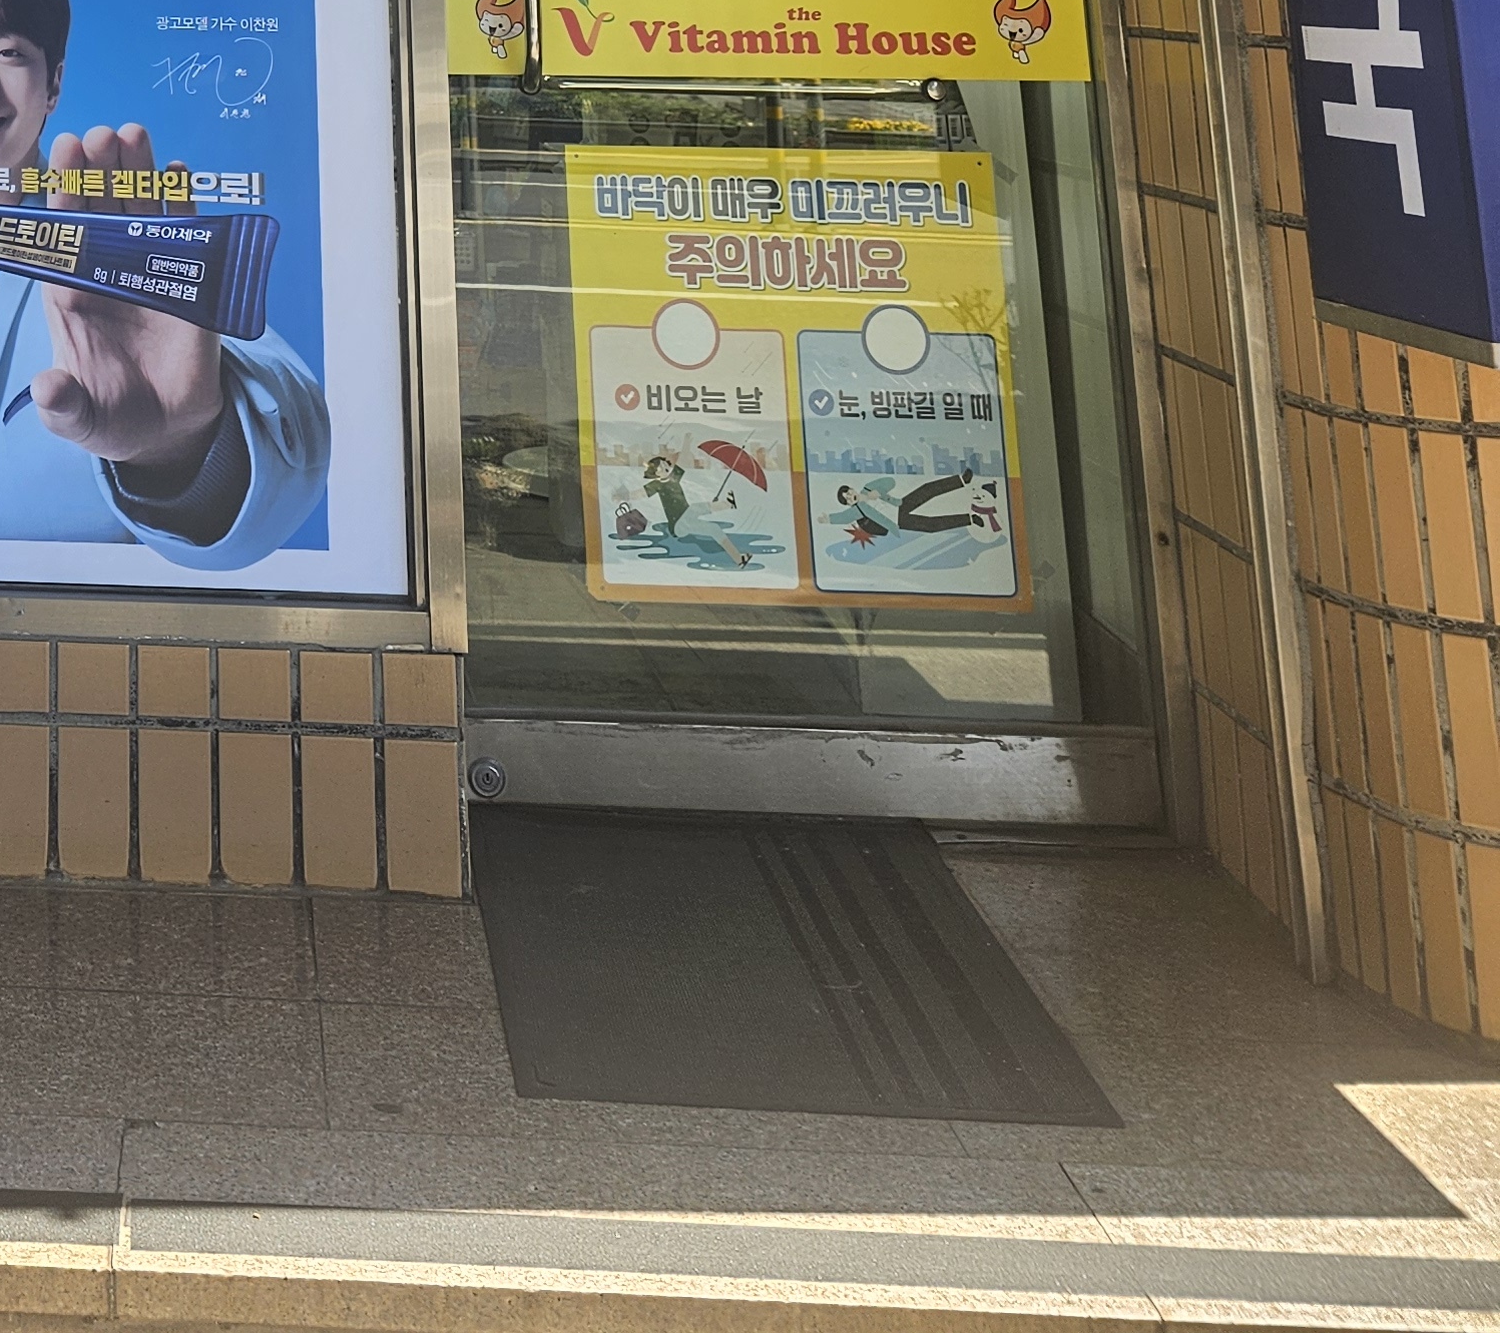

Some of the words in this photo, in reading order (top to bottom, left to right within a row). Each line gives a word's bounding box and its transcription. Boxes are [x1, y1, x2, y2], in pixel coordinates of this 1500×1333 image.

[156, 16, 209, 31] 광고모델
[210, 17, 238, 32] 가수
[240, 17, 279, 32] 이찬원
[786, 6, 822, 21] the
[629, 20, 822, 54] Vitamin
[834, 22, 977, 57] House
[21, 166, 105, 197] 흡수빠른
[110, 170, 265, 206] 겔타입으로!
[595, 173, 705, 221] 바닥이
[710, 175, 784, 224] 매우
[789, 177, 973, 227] 미끄러우니
[145, 224, 213, 244] 동아제약
[151, 257, 200, 279] 일반의약품
[666, 232, 909, 292] 주의하세요
[93, 266, 108, 285] 8g
[118, 271, 198, 302] 퇴행성관절염
[645, 383, 728, 415] 비오는
[735, 385, 763, 415] 날
[837, 389, 867, 421] 눈,
[871, 389, 936, 421] 빙판길
[943, 391, 965, 422] 일
[970, 392, 994, 423] 때
